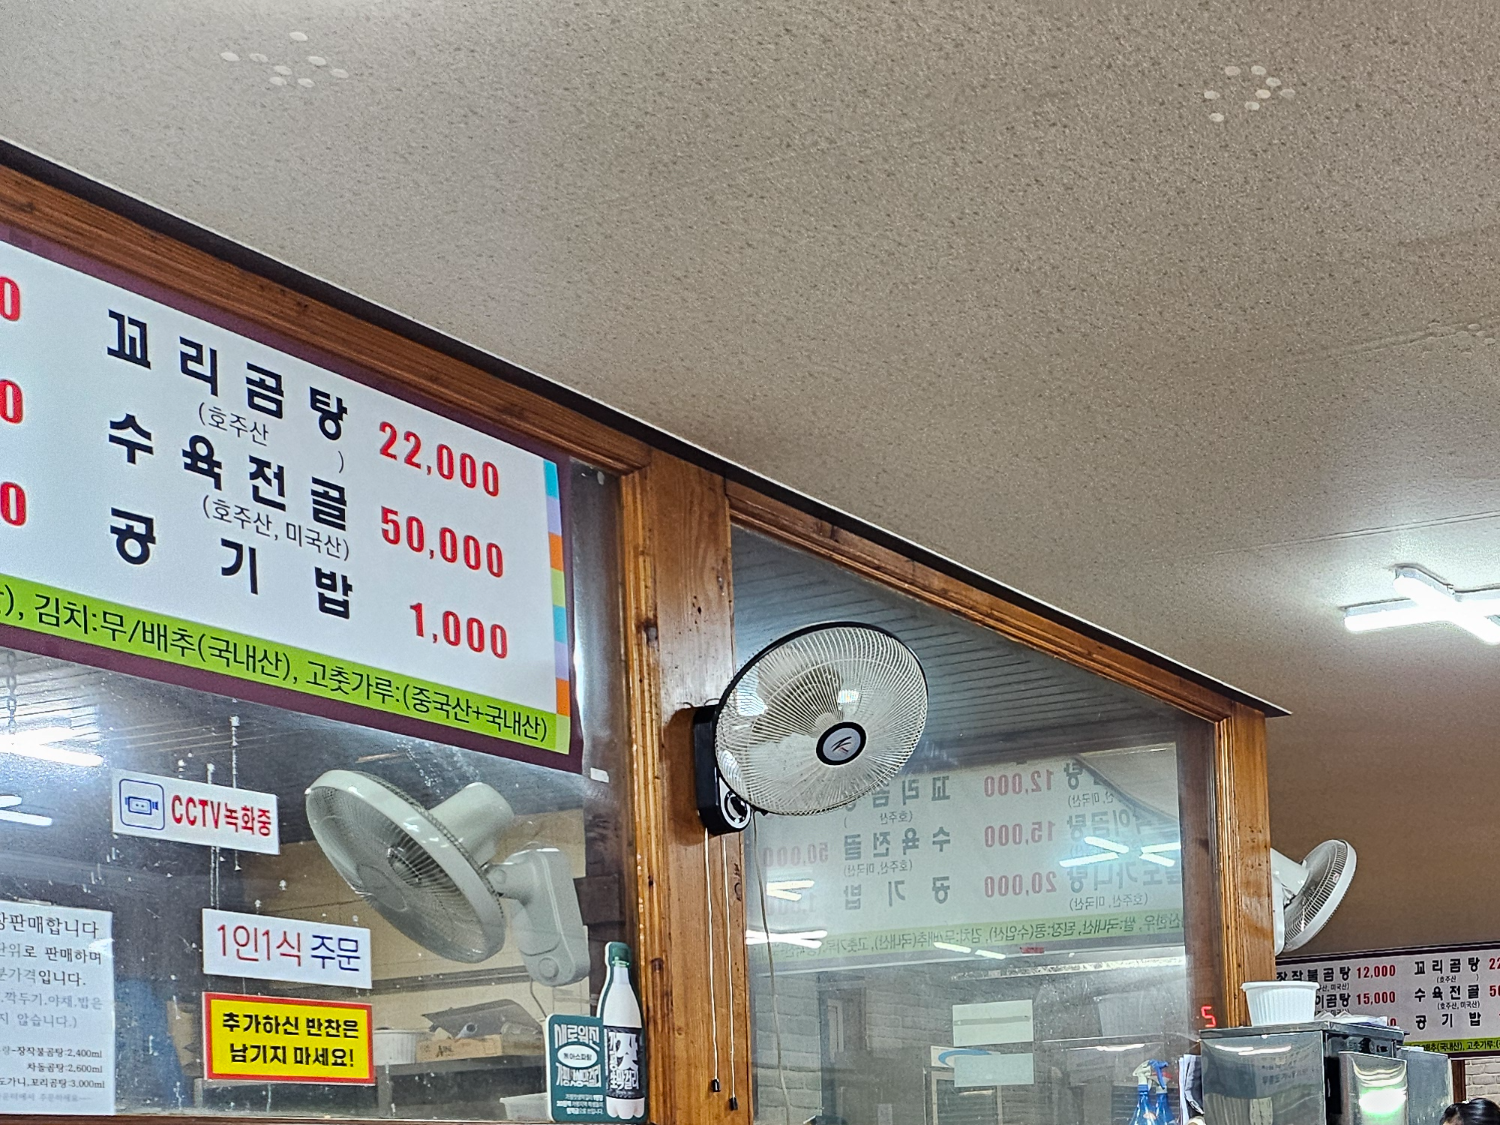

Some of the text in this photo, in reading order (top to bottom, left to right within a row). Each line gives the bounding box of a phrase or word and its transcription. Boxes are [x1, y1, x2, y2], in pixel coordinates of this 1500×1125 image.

[379, 421, 500, 497] 22,000
[380, 505, 504, 578] 50,000
[409, 602, 508, 658] 1,000
[217, 924, 361, 972] 1인1식 주문
[1357, 965, 1396, 979] 12,000
[1357, 991, 1396, 1005] 15,000
[222, 1012, 359, 1039] 추가하신 반찬은
[230, 1043, 354, 1067] 남기지 마세요!
